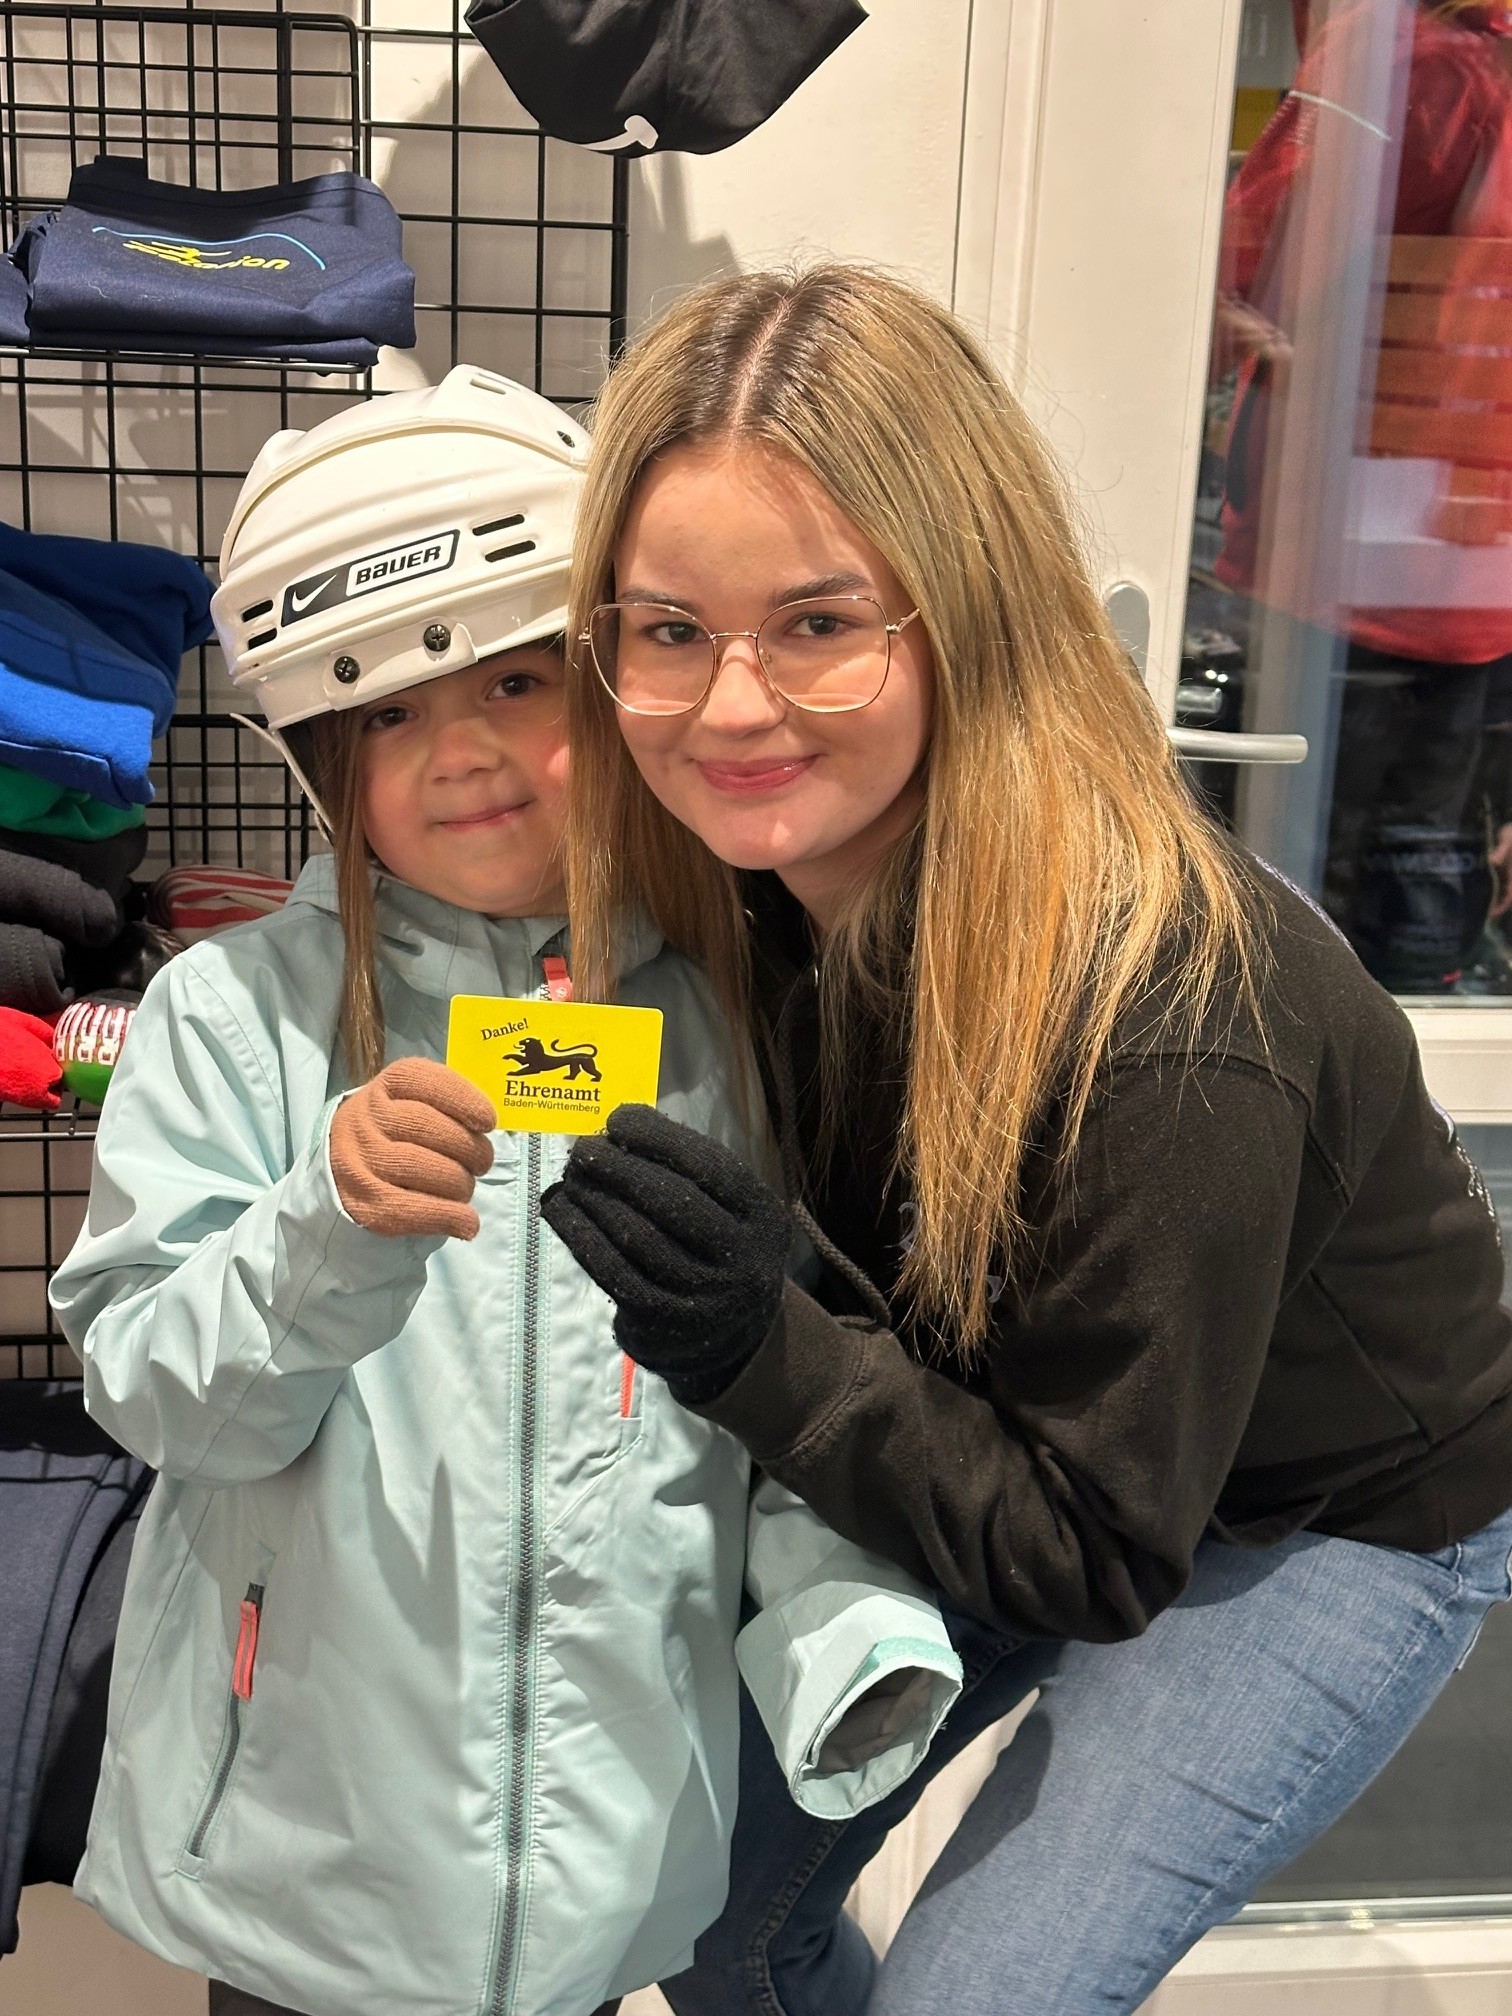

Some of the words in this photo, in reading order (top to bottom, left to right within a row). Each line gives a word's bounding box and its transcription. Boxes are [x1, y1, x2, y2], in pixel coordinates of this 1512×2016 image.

[481, 1018, 529, 1040] Danke!
[505, 1080, 601, 1102] Ehrenamt
[504, 1098, 600, 1114] Baden-Württemberg
